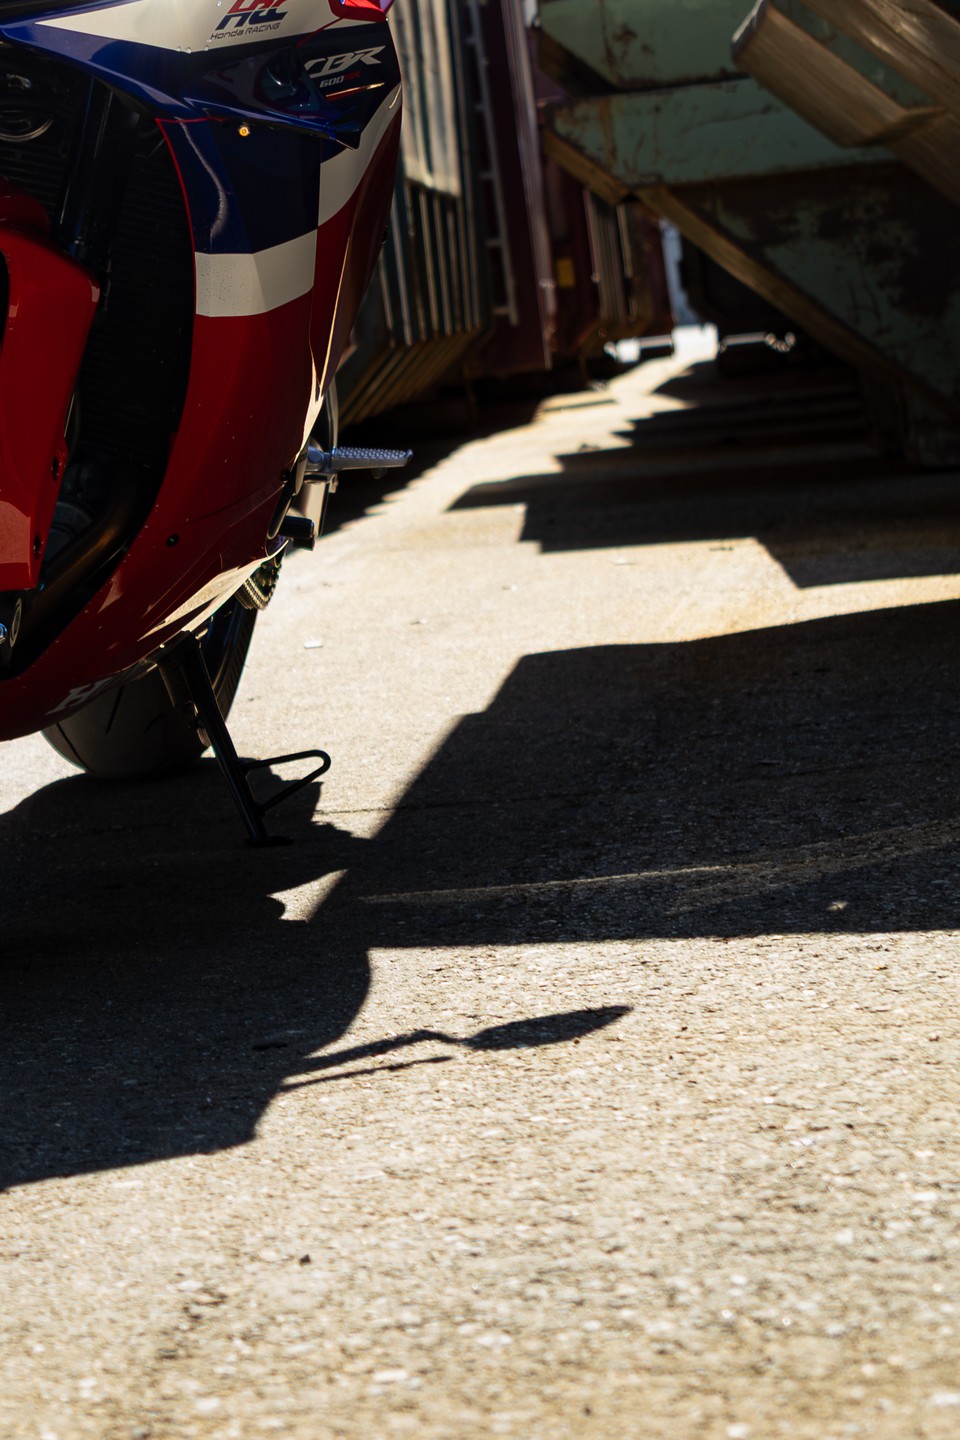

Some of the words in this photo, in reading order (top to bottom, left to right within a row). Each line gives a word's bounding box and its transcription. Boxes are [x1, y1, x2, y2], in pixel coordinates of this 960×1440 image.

[210, 29, 243, 40] Honda
[244, 22, 281, 35] RACING
[303, 45, 386, 79] CBR
